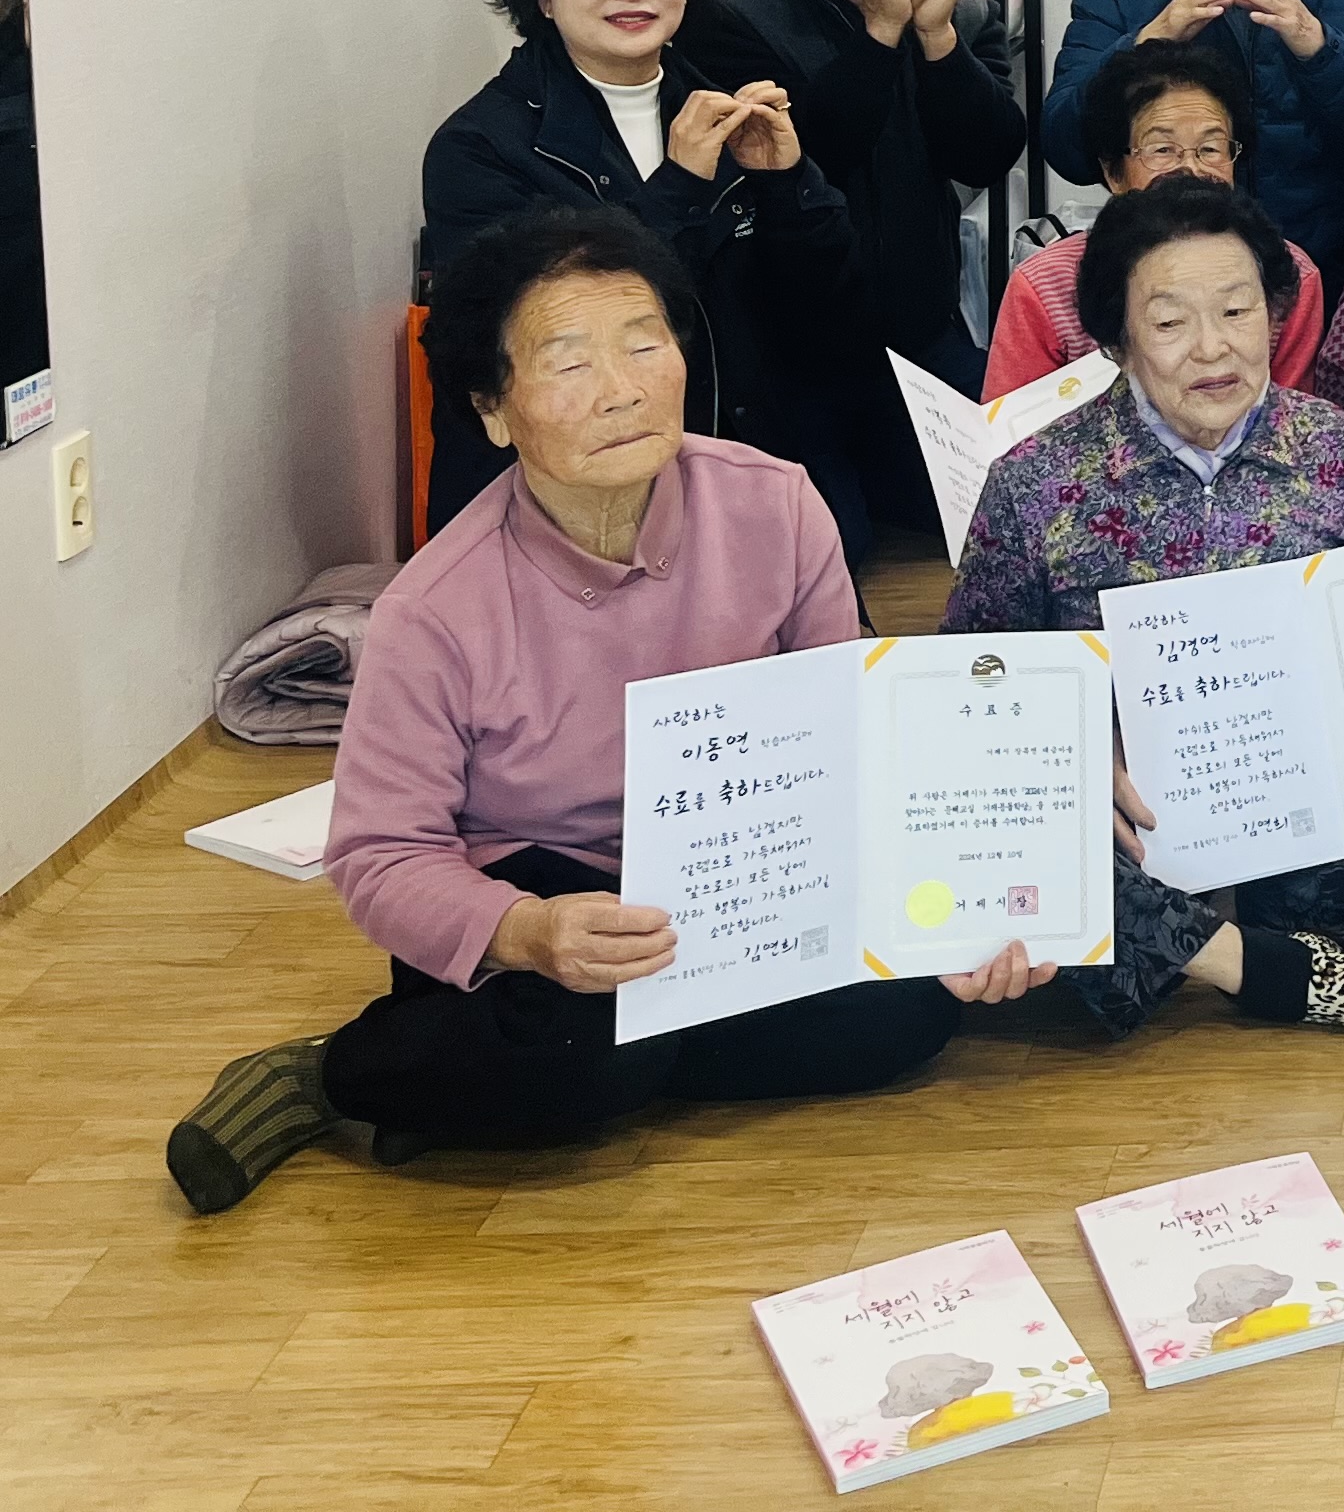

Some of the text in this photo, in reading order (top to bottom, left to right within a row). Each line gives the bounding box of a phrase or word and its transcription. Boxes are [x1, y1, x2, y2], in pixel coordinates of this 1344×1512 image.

[682, 731, 749, 762] 이동연
[1159, 1203, 1231, 1234] 세월에
[1191, 1219, 1236, 1242] 지지
[1240, 1203, 1279, 1230] 않고
[844, 1291, 920, 1328] 세월에
[880, 1309, 926, 1332] 지지
[934, 1287, 975, 1315] 않고
